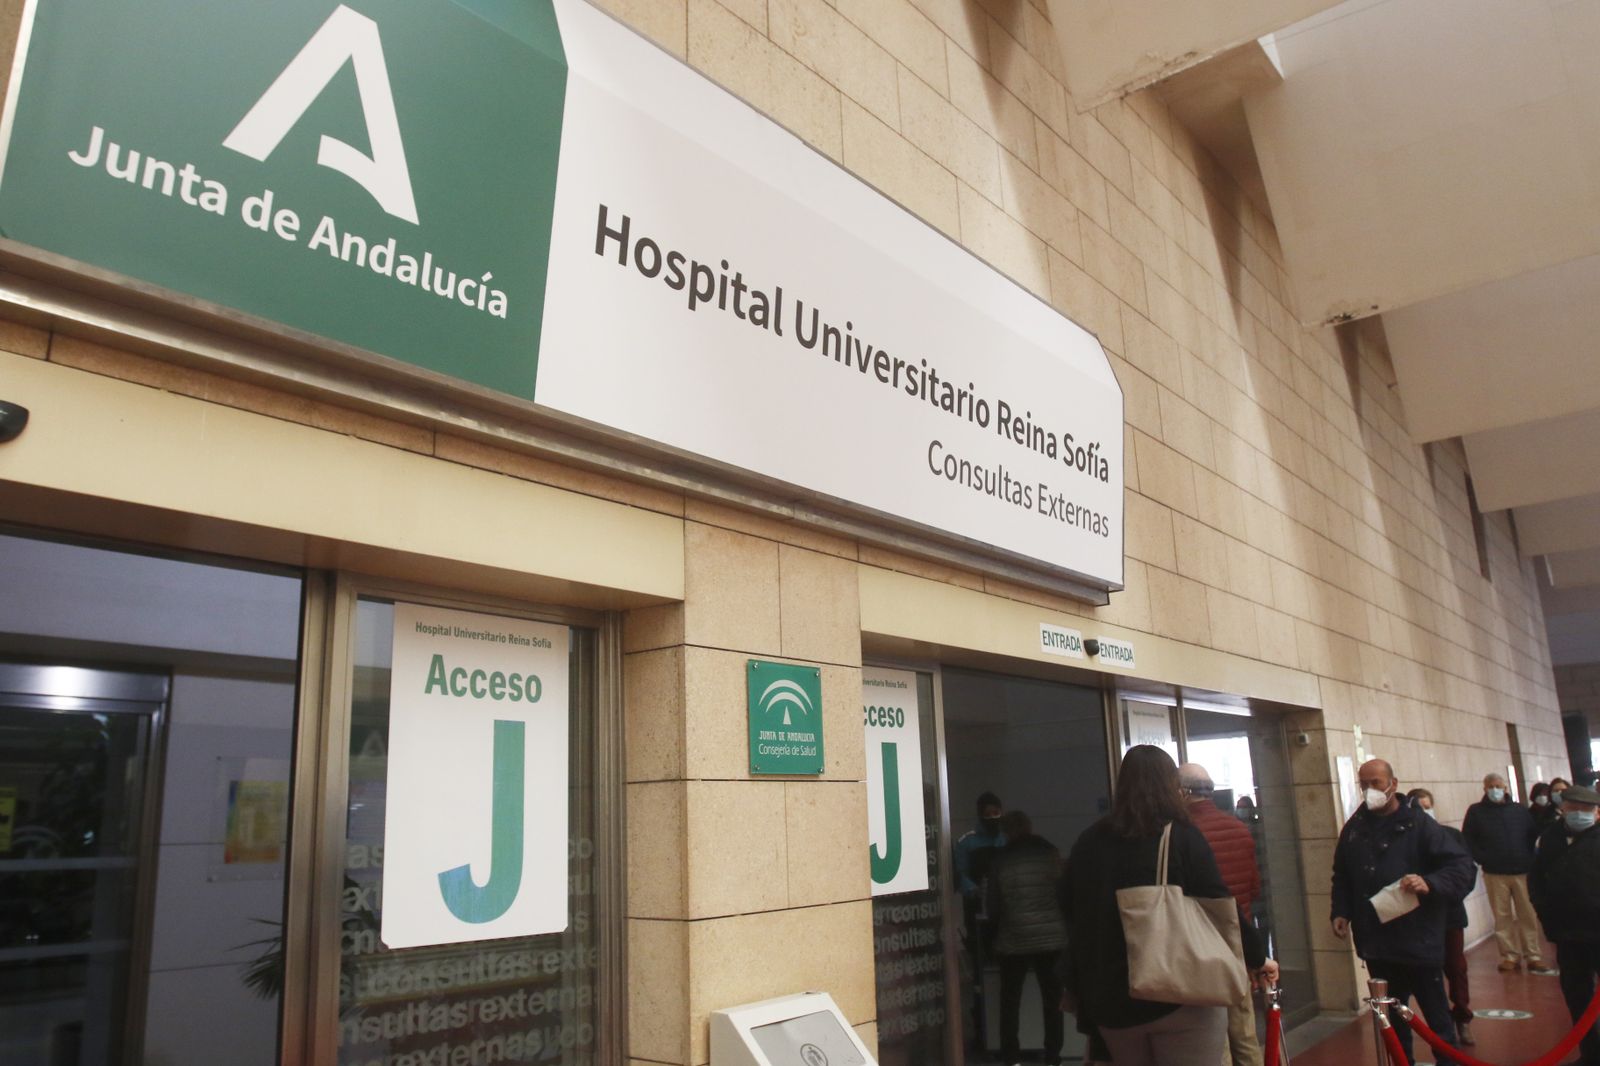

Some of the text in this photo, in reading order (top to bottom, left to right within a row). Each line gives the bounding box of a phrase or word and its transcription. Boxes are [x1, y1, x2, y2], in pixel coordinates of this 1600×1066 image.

[68, 125, 509, 319] Junta de Andalucía
[595, 203, 1109, 484] Hospital Universitario Reina Sofía
[928, 439, 1109, 538] Consultas Externas
[415, 621, 451, 637] Hospital
[453, 627, 506, 644] Universitario
[508, 633, 530, 647] Reina
[1042, 629, 1082, 652] ENTRADA
[1100, 642, 1134, 662] ENTRADA
[424, 653, 542, 703] Acceso
[758, 730, 777, 741] JUNTA
[778, 731, 786, 741] DE
[791, 745, 800, 756] de
[800, 745, 817, 756] Salud
[438, 719, 526, 924] J
